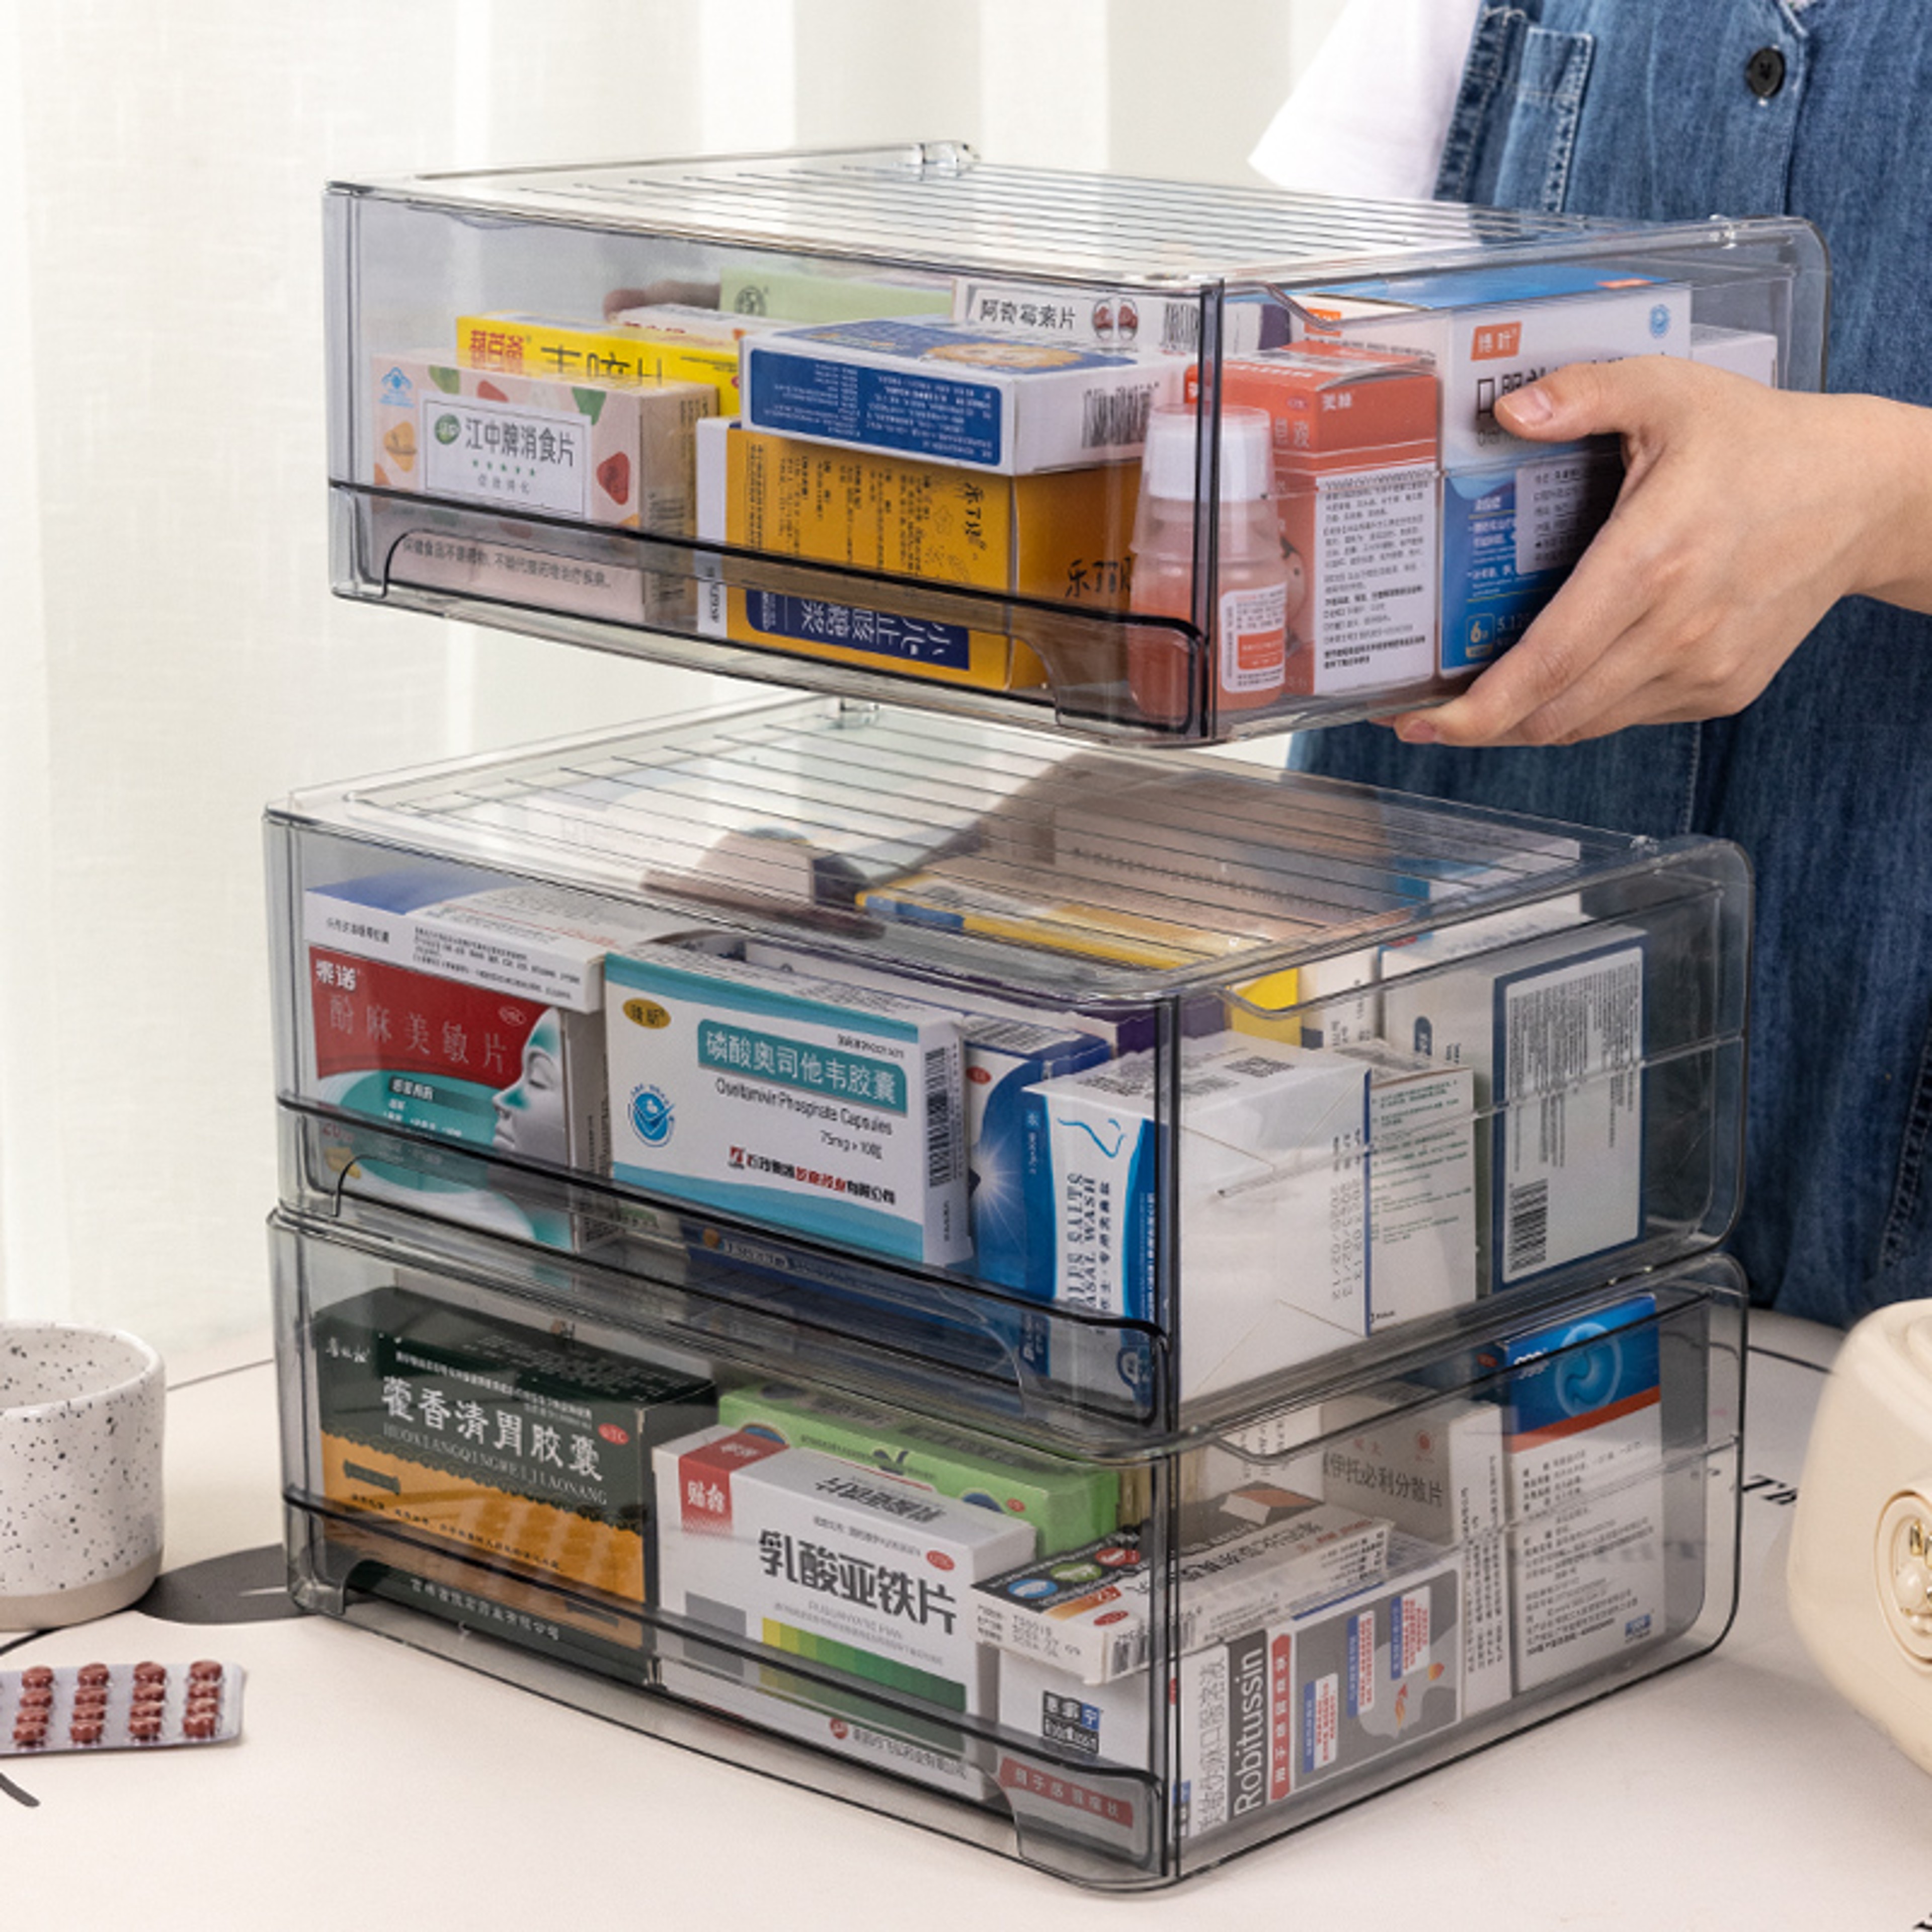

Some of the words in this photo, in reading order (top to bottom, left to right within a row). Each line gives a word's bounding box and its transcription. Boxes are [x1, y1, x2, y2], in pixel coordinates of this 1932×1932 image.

[980, 299, 1075, 330] 阿奇霉素片
[465, 416, 576, 468] 江中牌消食片
[330, 995, 507, 1074] 酚麻美敏片
[705, 1030, 897, 1104] 磷酸奥司他韦胶囊
[840, 1106, 893, 1136] Capsules
[1083, 1177, 1096, 1243] WASH
[381, 1376, 603, 1481] 藿香清胃胶囊
[1323, 1451, 1443, 1507] 伊托必利分散片
[759, 1530, 957, 1635] 乳酸亚铁片
[1234, 1647, 1264, 1817] Robitussin
